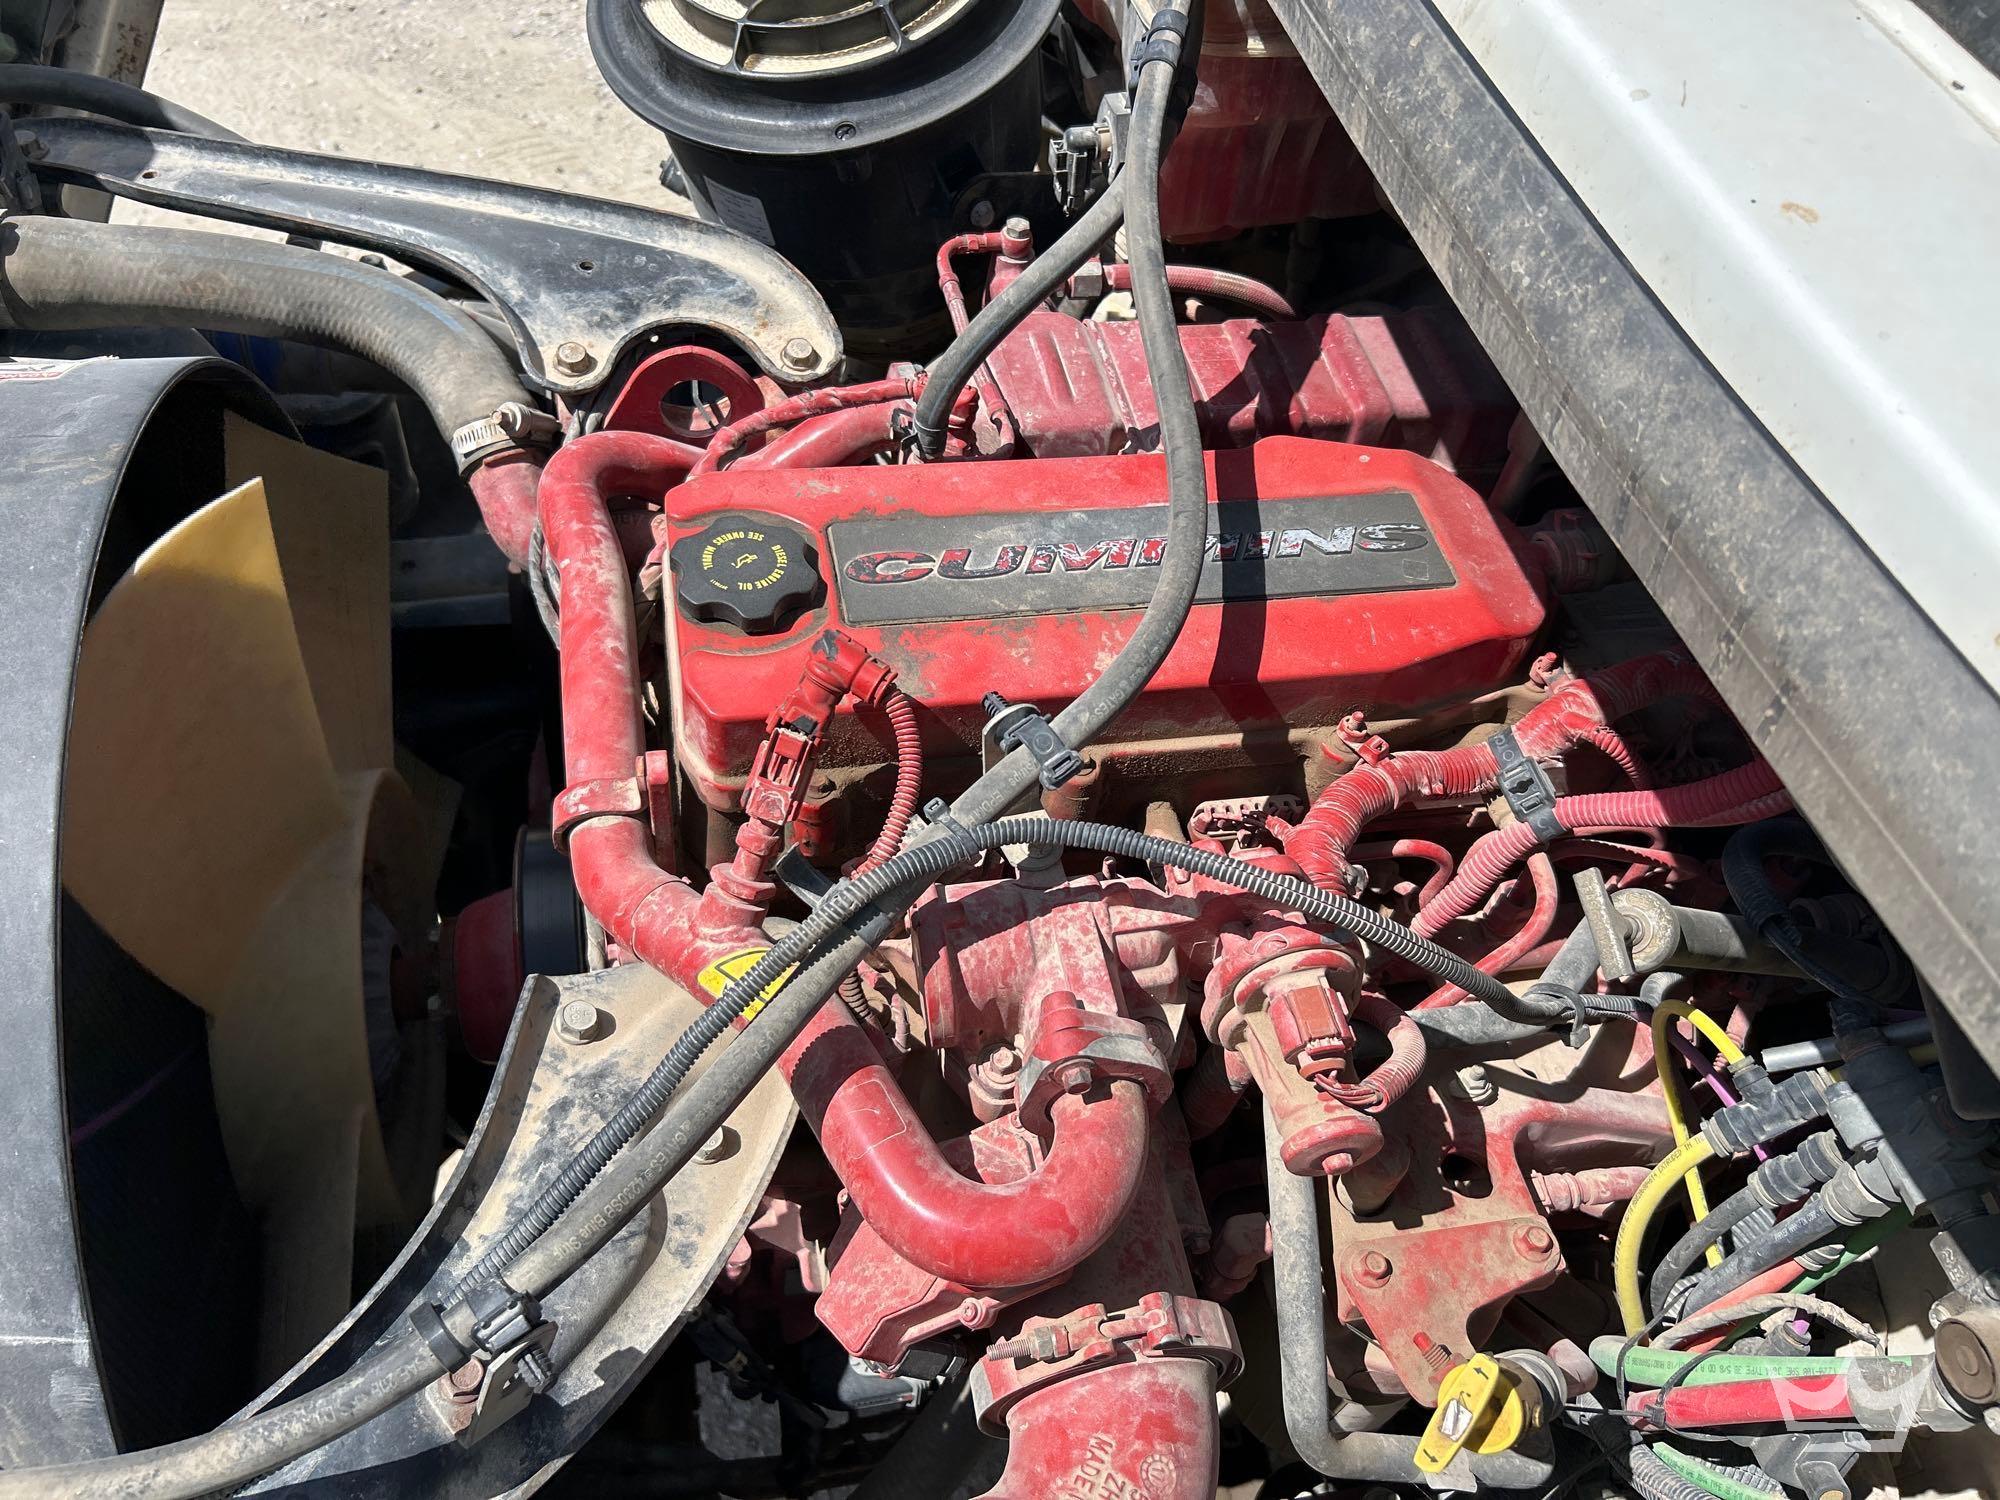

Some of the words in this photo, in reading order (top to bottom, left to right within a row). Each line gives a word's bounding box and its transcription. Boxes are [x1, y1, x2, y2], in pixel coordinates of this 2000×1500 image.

[747, 531, 765, 542] SEE
[844, 522, 1429, 585] CUMMINS
[579, 1213, 608, 1239] Blue
